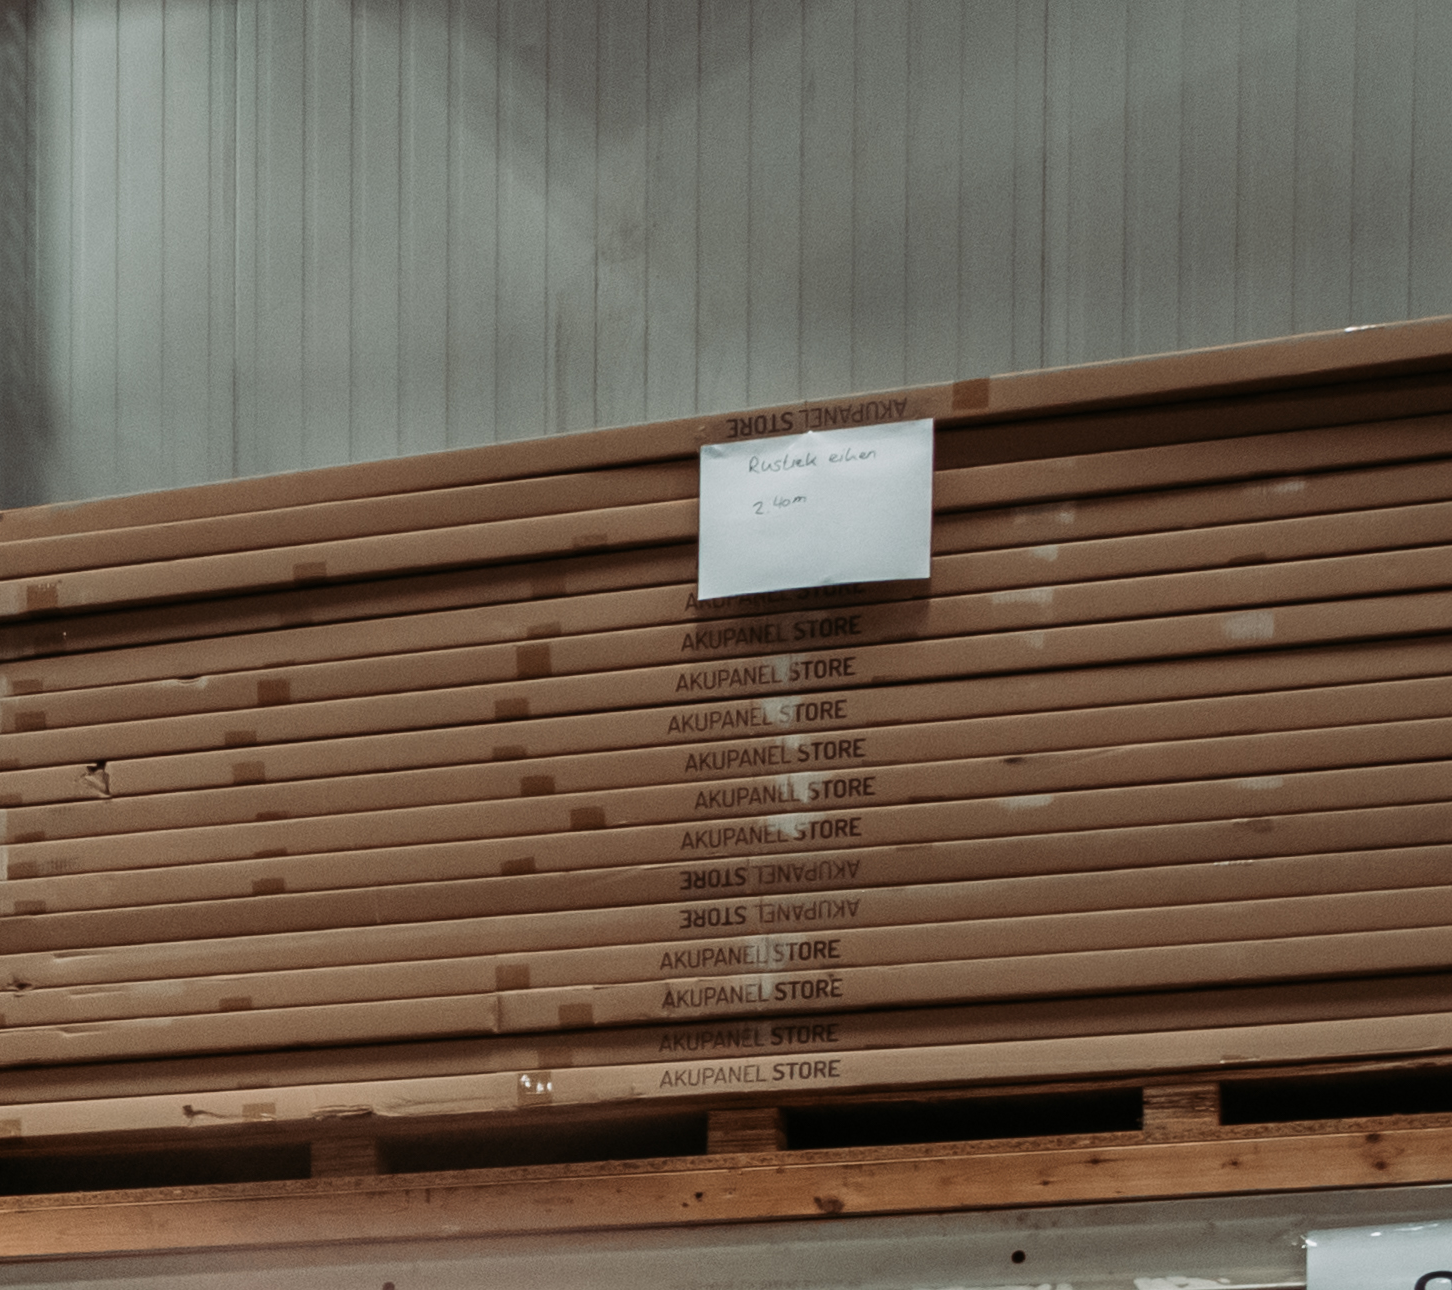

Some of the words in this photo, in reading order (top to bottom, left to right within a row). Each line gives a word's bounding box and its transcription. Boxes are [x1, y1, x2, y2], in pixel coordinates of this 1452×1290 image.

[726, 411, 793, 438] STORE
[799, 398, 907, 428] AKUPANEL
[681, 624, 787, 651] AKUPANEL
[794, 615, 861, 641] STORE
[676, 665, 782, 692] AKUPANEL
[789, 657, 856, 682] STORE
[667, 708, 772, 735] AKUPANEL
[779, 700, 847, 723] STORE
[685, 746, 792, 772] AKUPANEL
[798, 738, 866, 762] STORE
[695, 785, 800, 810] AKUPANEL
[808, 776, 876, 801] STORE
[681, 826, 788, 850] AKUPANEL
[793, 817, 862, 841] STORE
[680, 866, 747, 891] STORE
[751, 859, 860, 885] AKUPANEL
[680, 905, 747, 929] STORE
[751, 898, 860, 924] AKUPANEL
[660, 945, 768, 971] AKUPANEL
[772, 939, 841, 962] STORE
[662, 984, 769, 1009] AKUPANEL
[774, 978, 843, 1001] STORE
[659, 1029, 765, 1052] AKUPANEL
[770, 1023, 839, 1046] STORE
[660, 1065, 767, 1089] AKUPANEL
[772, 1059, 841, 1082] STORE
